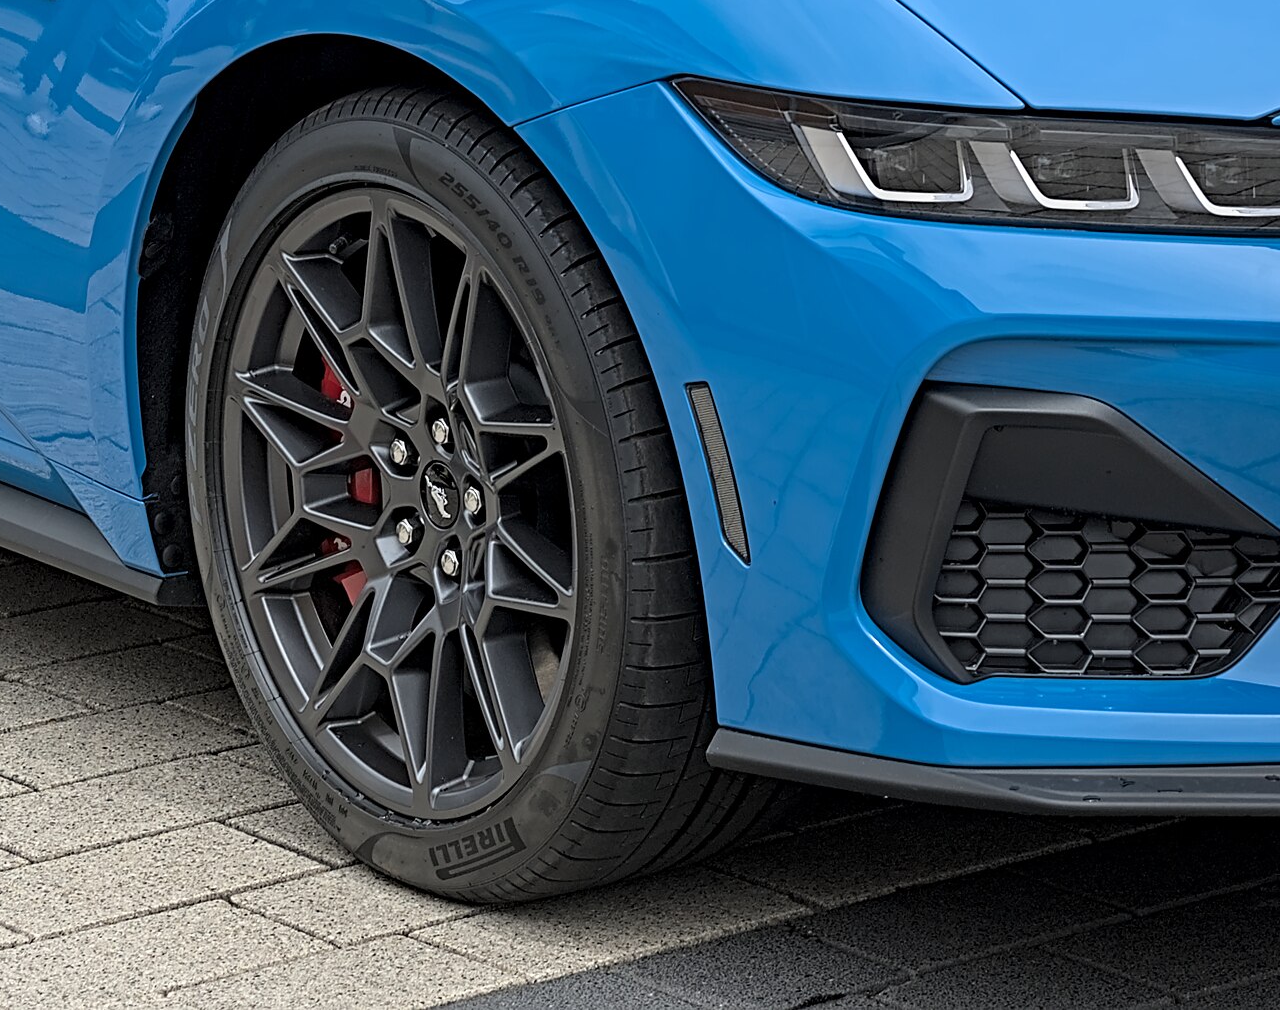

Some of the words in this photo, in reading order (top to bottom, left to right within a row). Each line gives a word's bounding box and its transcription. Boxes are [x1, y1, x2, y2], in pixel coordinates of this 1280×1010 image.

[438, 172, 513, 249] 255/40
[187, 295, 210, 472] ZERO
[428, 817, 527, 881] PIRELLI
